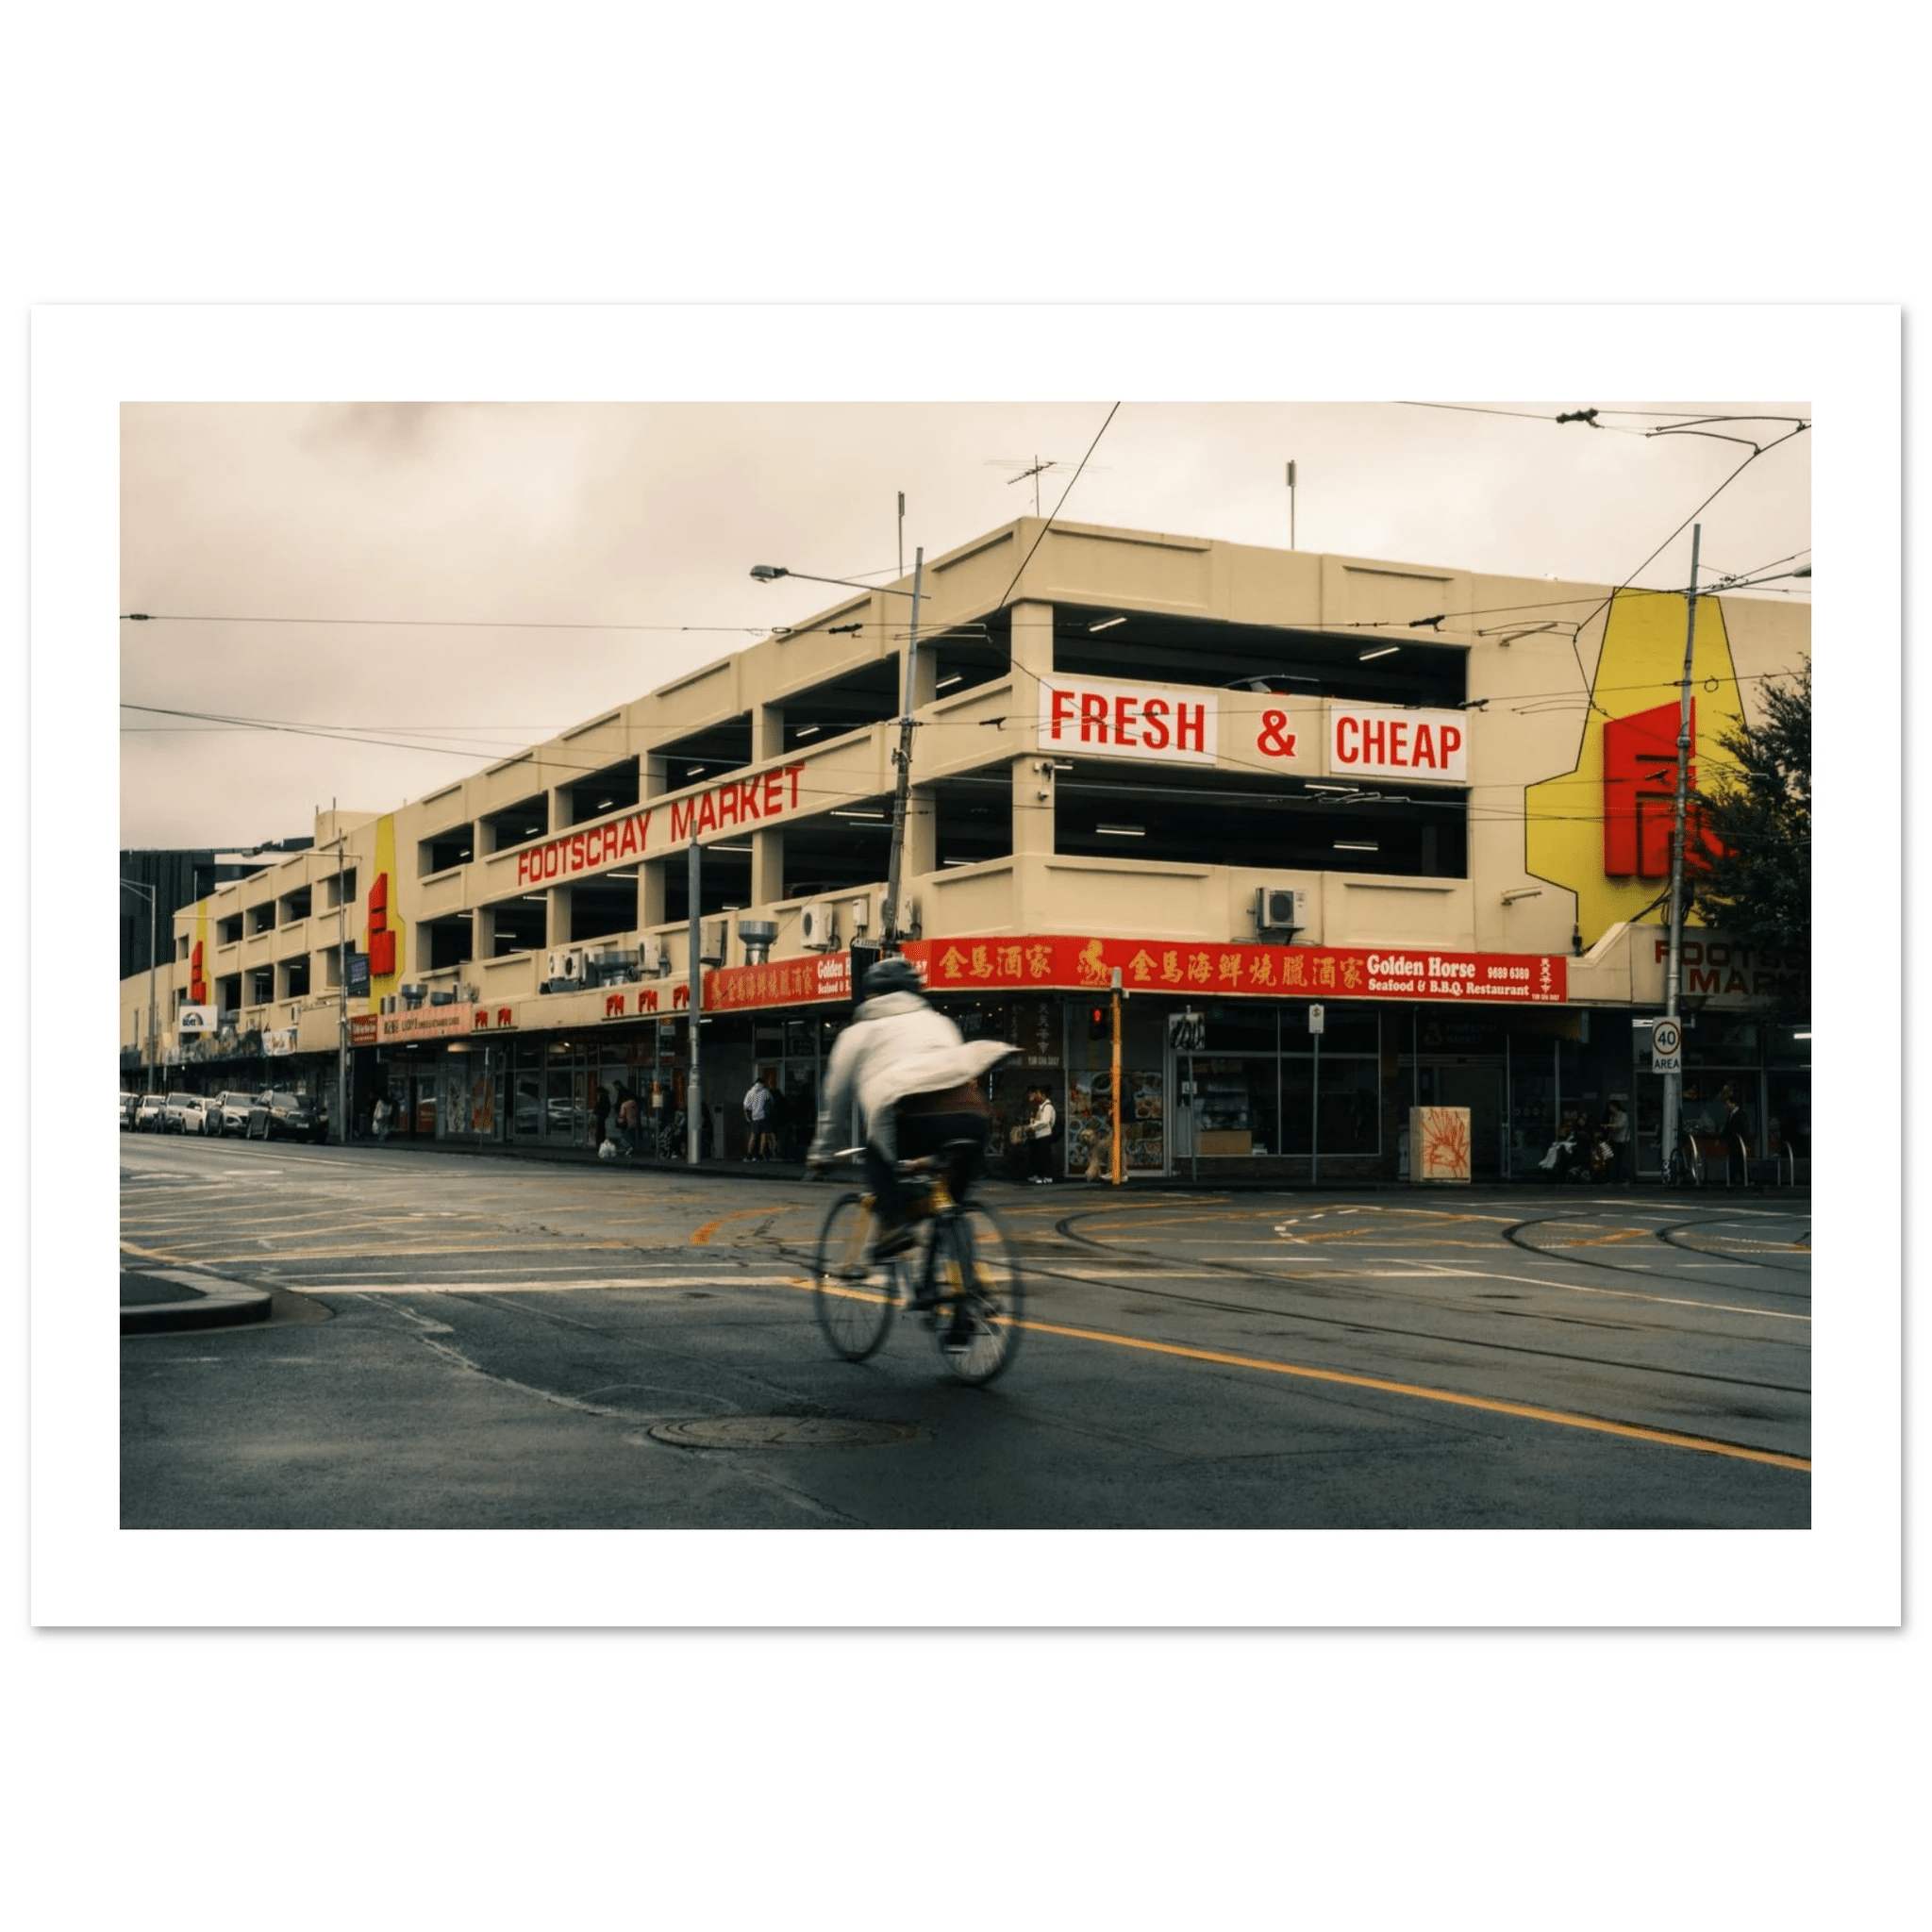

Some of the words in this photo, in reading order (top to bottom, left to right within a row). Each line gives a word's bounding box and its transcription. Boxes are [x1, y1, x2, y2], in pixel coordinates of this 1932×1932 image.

[1051, 691, 1205, 753] FRESH
[1257, 708, 1296, 758] &
[1336, 716, 1461, 770] CHEAP
[518, 809, 653, 888] FOOTSCRAY
[671, 760, 806, 842] MARKET
[939, 944, 1053, 979] 金馬酒家
[1367, 955, 1424, 976] Golden
[1428, 957, 1475, 978] Horse
[1368, 978, 1413, 991] Seafood
[1466, 982, 1529, 995] Restaurant
[1657, 1030, 1675, 1045] 40
[1655, 1058, 1679, 1069] AREA
